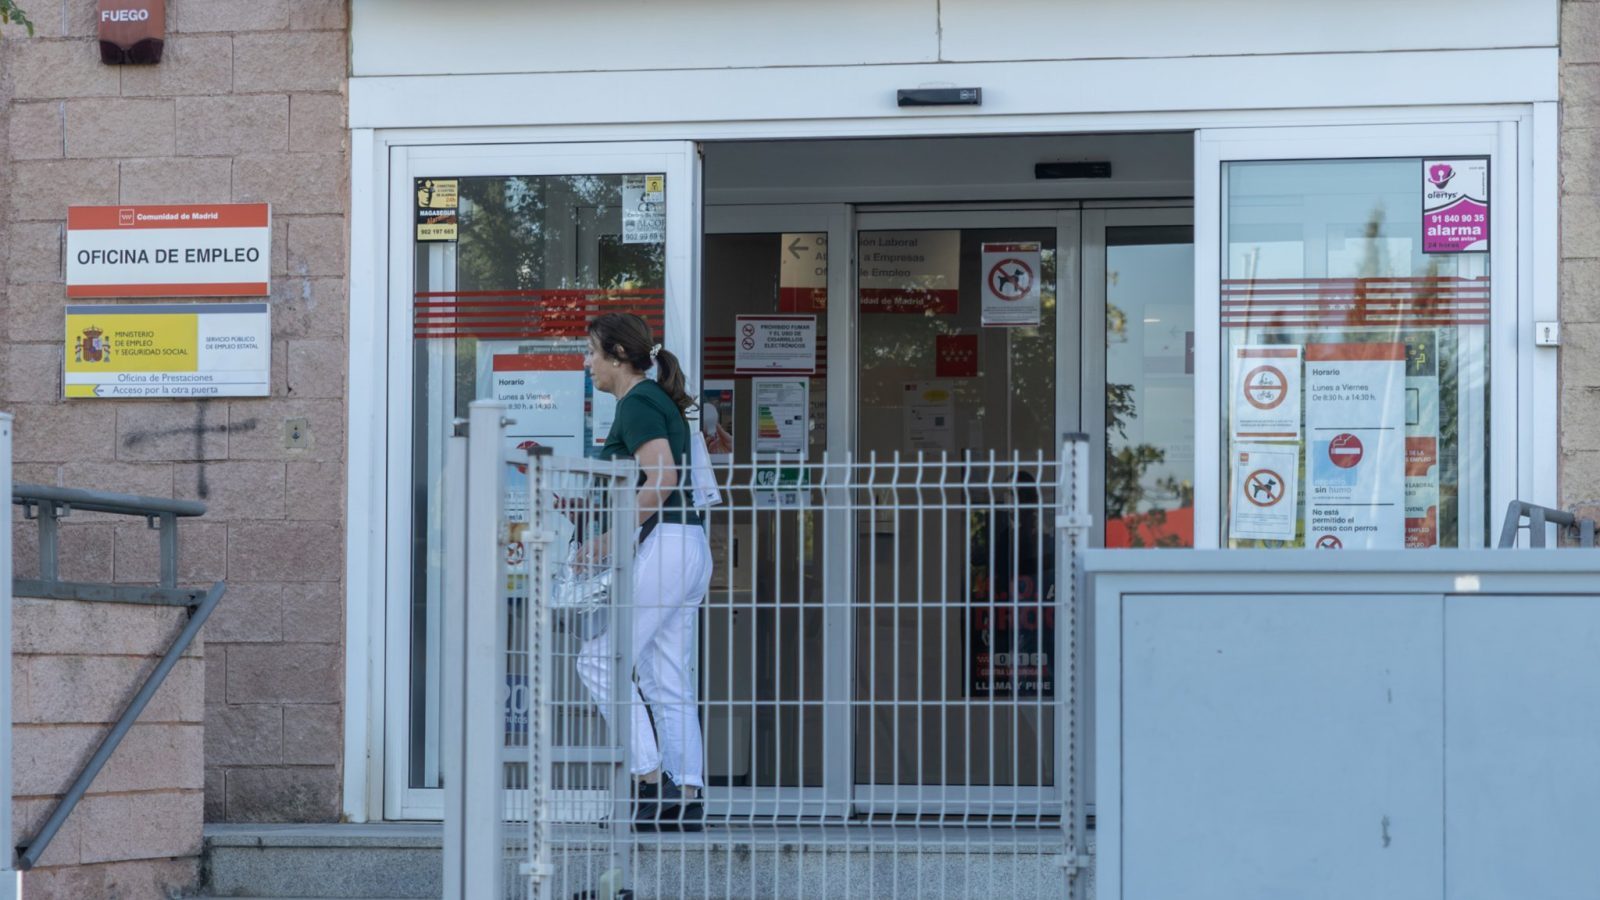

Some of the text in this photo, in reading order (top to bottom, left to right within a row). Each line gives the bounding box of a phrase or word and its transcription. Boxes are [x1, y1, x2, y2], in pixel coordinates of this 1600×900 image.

[101, 8, 149, 22] FUEGO
[1427, 191, 1457, 199] alertys
[136, 212, 219, 221] Comunidad de Madrid
[1432, 215, 1442, 223] 91
[1461, 214, 1472, 222] 90
[1474, 214, 1484, 222] 35
[1427, 224, 1481, 236] alarma
[878, 237, 918, 246] Laboral
[77, 247, 259, 265] OFICINA DE EMPLEO
[863, 253, 924, 263] a Empresas
[872, 268, 911, 278] Empleo
[894, 296, 924, 305] Madrid
[126, 339, 153, 347] EMPLEO
[231, 335, 255, 343] PÚBLICO
[121, 348, 161, 356] SEGURIDAD
[1312, 368, 1340, 376] Horario
[117, 373, 213, 382] Oficina de Prestaciones
[113, 386, 218, 397] Acceso por la otra puerta
